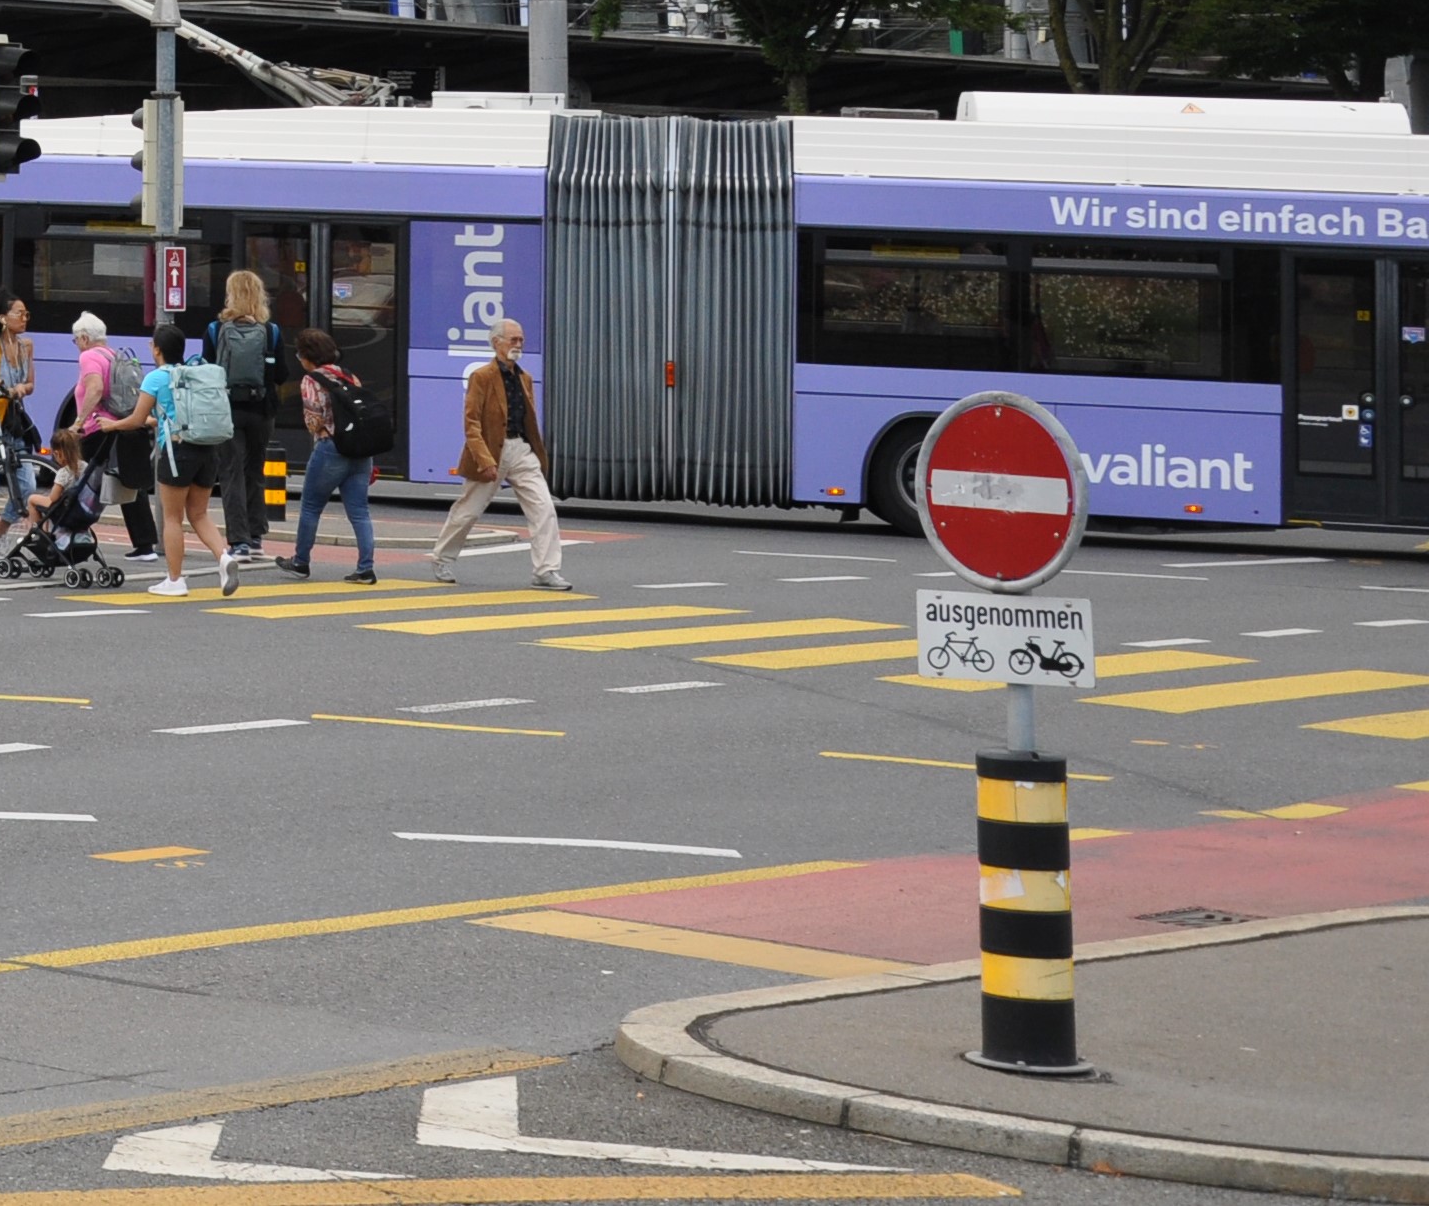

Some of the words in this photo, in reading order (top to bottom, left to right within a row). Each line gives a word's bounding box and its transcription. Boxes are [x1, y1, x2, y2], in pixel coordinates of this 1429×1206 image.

[1050, 196, 1117, 226] Wir
[1126, 200, 1208, 231] sind
[1218, 203, 1365, 236] einfach
[1377, 207, 1429, 239] Ba
[446, 224, 505, 391] liant
[1079, 444, 1254, 491] valiant
[926, 603, 1083, 631] ausgenommen
